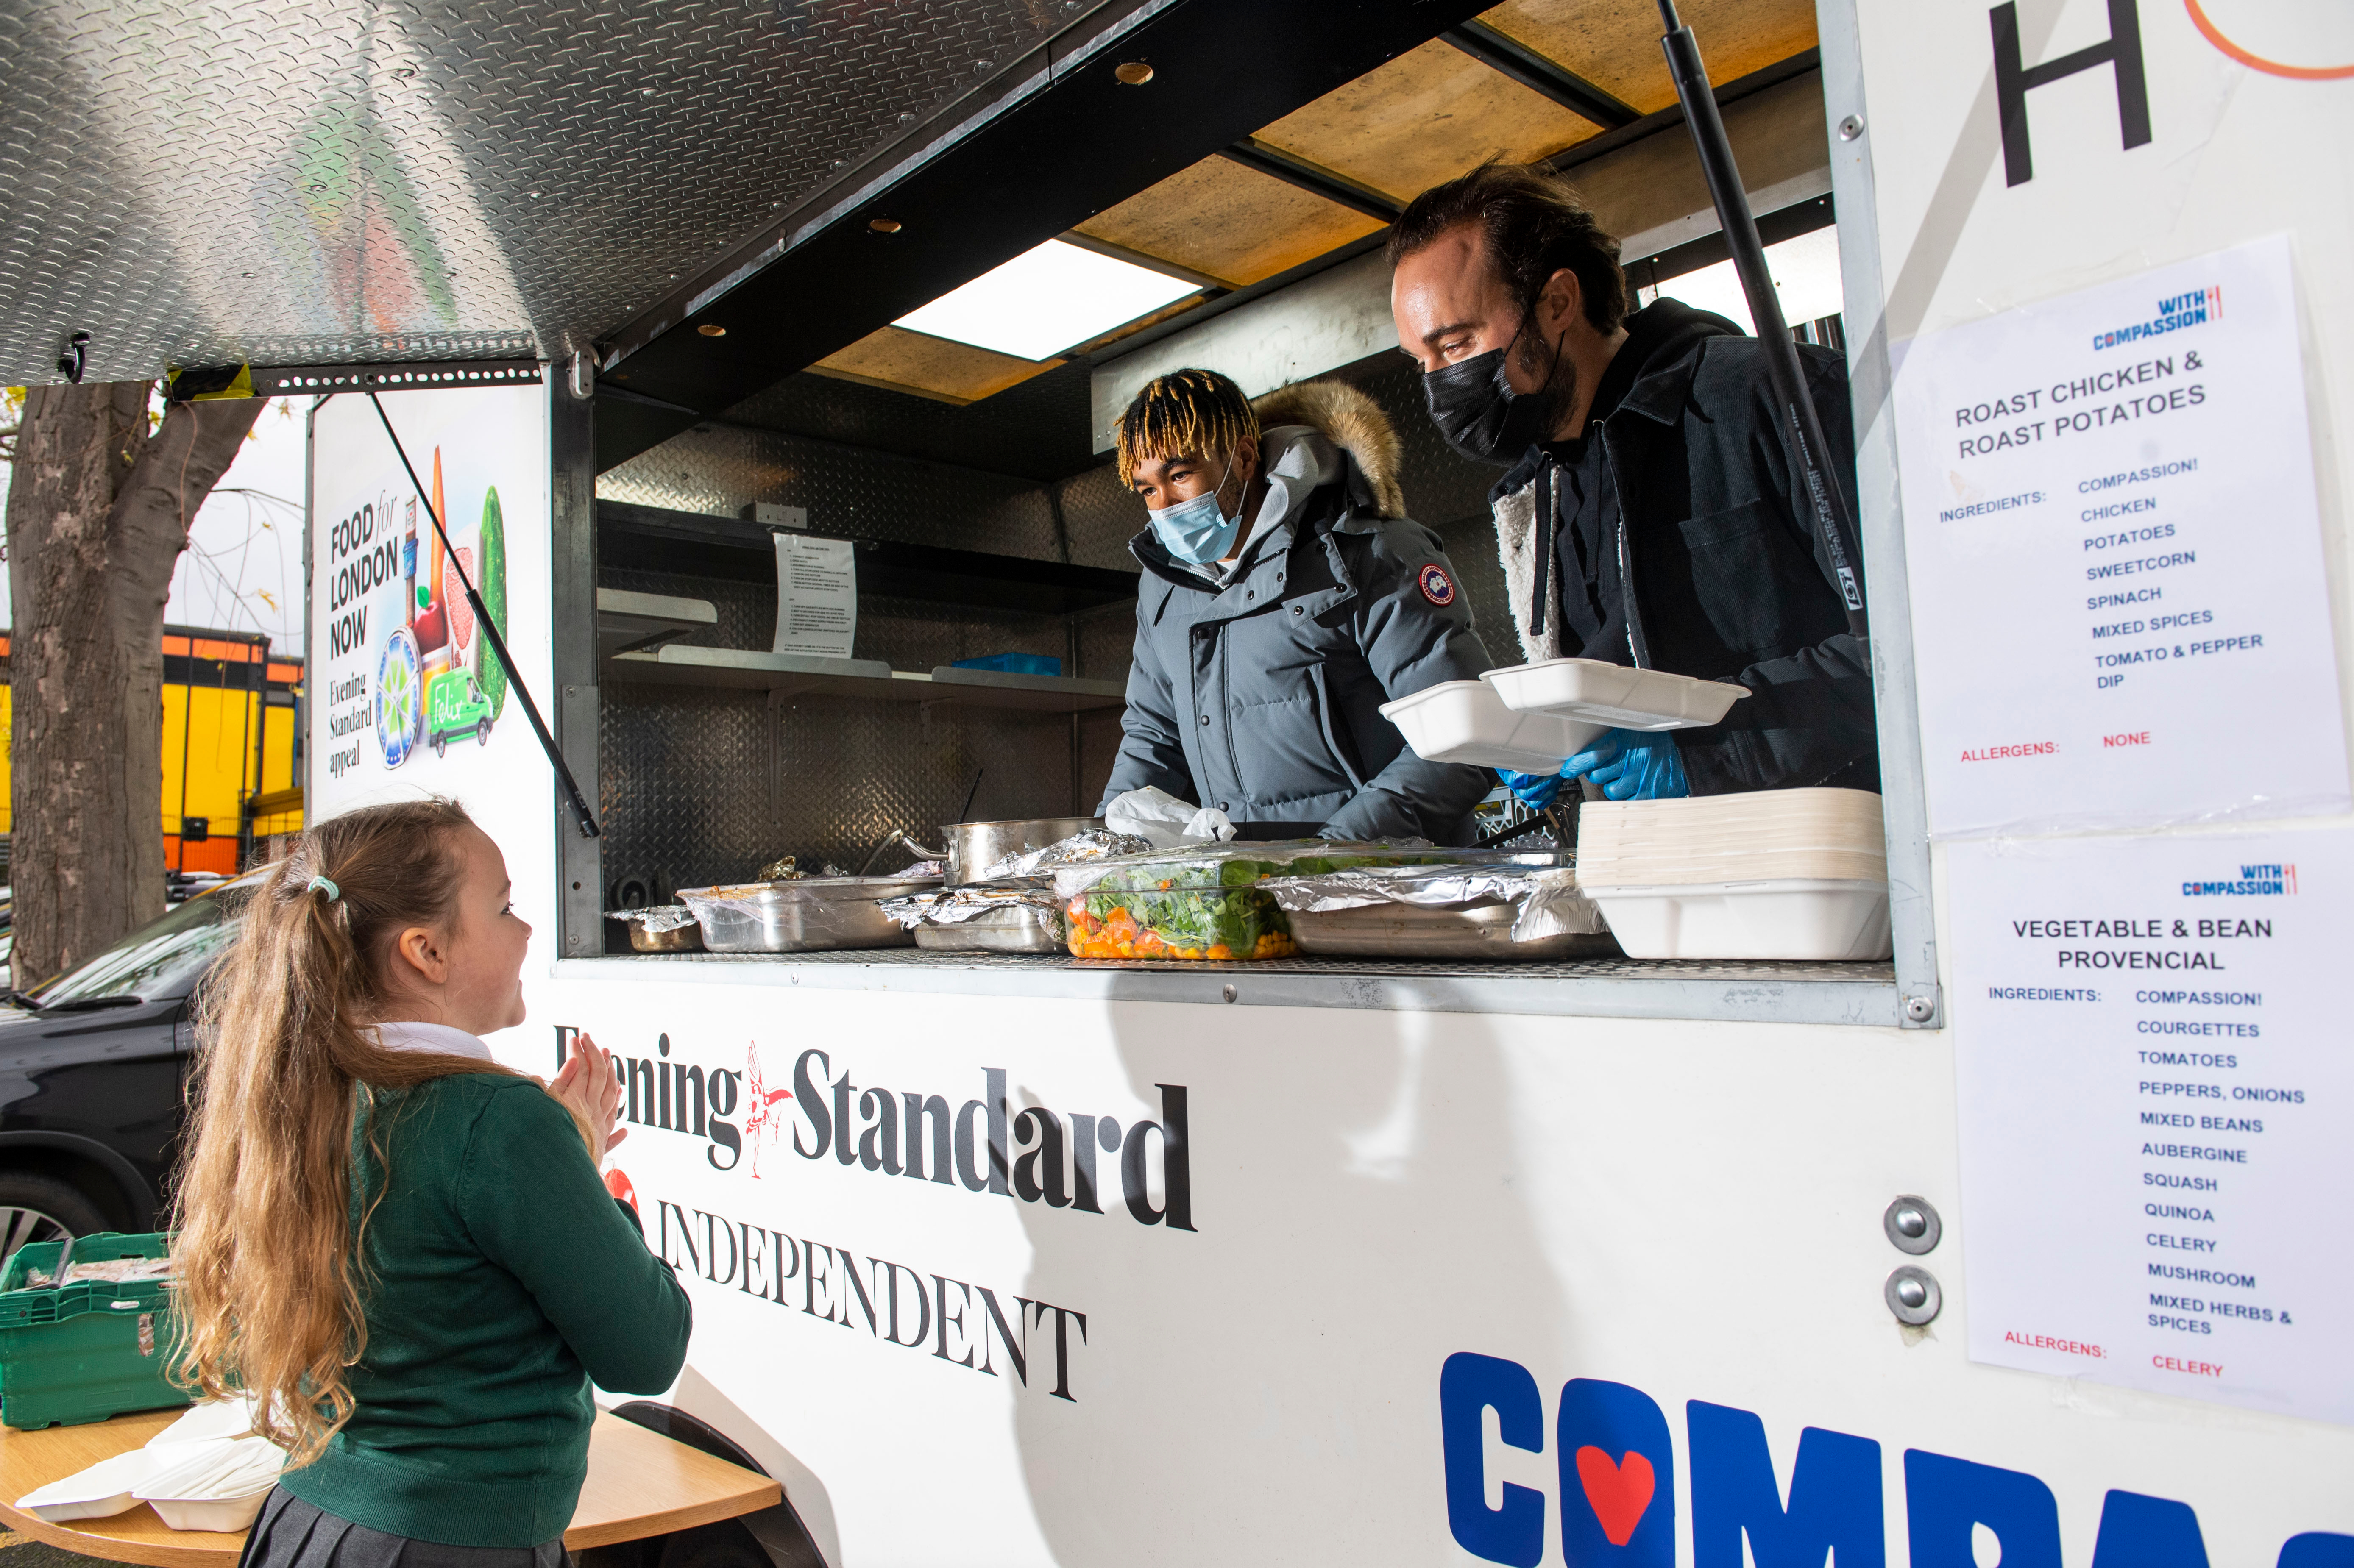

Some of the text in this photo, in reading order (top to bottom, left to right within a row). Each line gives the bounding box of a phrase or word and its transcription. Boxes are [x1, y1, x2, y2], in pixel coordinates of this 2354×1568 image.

[2159, 290, 2205, 315] WITH
[2094, 307, 2207, 350] COMPASSION
[1956, 350, 2203, 428] ROAST CHICKEN &
[1959, 384, 2206, 459] ROAST POTATOES
[1939, 458, 2198, 523] INGREDIENTS: COMPASSION!
[2081, 497, 2156, 522] CHICKEN
[332, 490, 397, 564] FOOD for
[2084, 523, 2176, 551] POTATOES
[332, 537, 398, 612] LONDON
[2087, 550, 2196, 580] SWEETCORN
[2087, 587, 2162, 610] SPINACH
[331, 606, 367, 660] NOW
[2092, 610, 2213, 639] MIXED SPICES
[2095, 634, 2263, 668] TOMATO & PEPPER
[331, 672, 366, 706] Evening
[2097, 674, 2124, 689] DIP
[435, 683, 462, 725] Felix
[330, 703, 371, 740] Standard
[330, 740, 359, 779] appeal
[1961, 731, 2151, 762] ALLERGENS: NONE
[2241, 865, 2282, 879] WITH
[2183, 881, 2283, 896] COMPASSION
[2013, 919, 2272, 938] VEGETABLE & BEAN
[2059, 951, 2225, 970] PROVENCIAL
[1989, 987, 2262, 1005] INGREDIENTS: COMPASSION!
[2137, 1020, 2260, 1037] COURGETTES
[2138, 1051, 2237, 1068] TOMATOES
[2139, 1081, 2305, 1104] PEPPERS, ONIONS
[2140, 1112, 2264, 1133] MIXED BEANS
[792, 1048, 1198, 1232] Standard
[2142, 1143, 2246, 1163] AUBERGINE
[2143, 1173, 2217, 1192] SQUASH
[2145, 1203, 2215, 1222] QUINOA
[2146, 1233, 2217, 1253] CELERY
[2148, 1263, 2256, 1288] MUSHROOM
[657, 1200, 1087, 1403] INDEPENDENT
[2150, 1293, 2292, 1324] MIXED HERBS &
[2148, 1314, 2212, 1334] SPICES
[2005, 1331, 2223, 1377] ALLERGENS: CELERY
